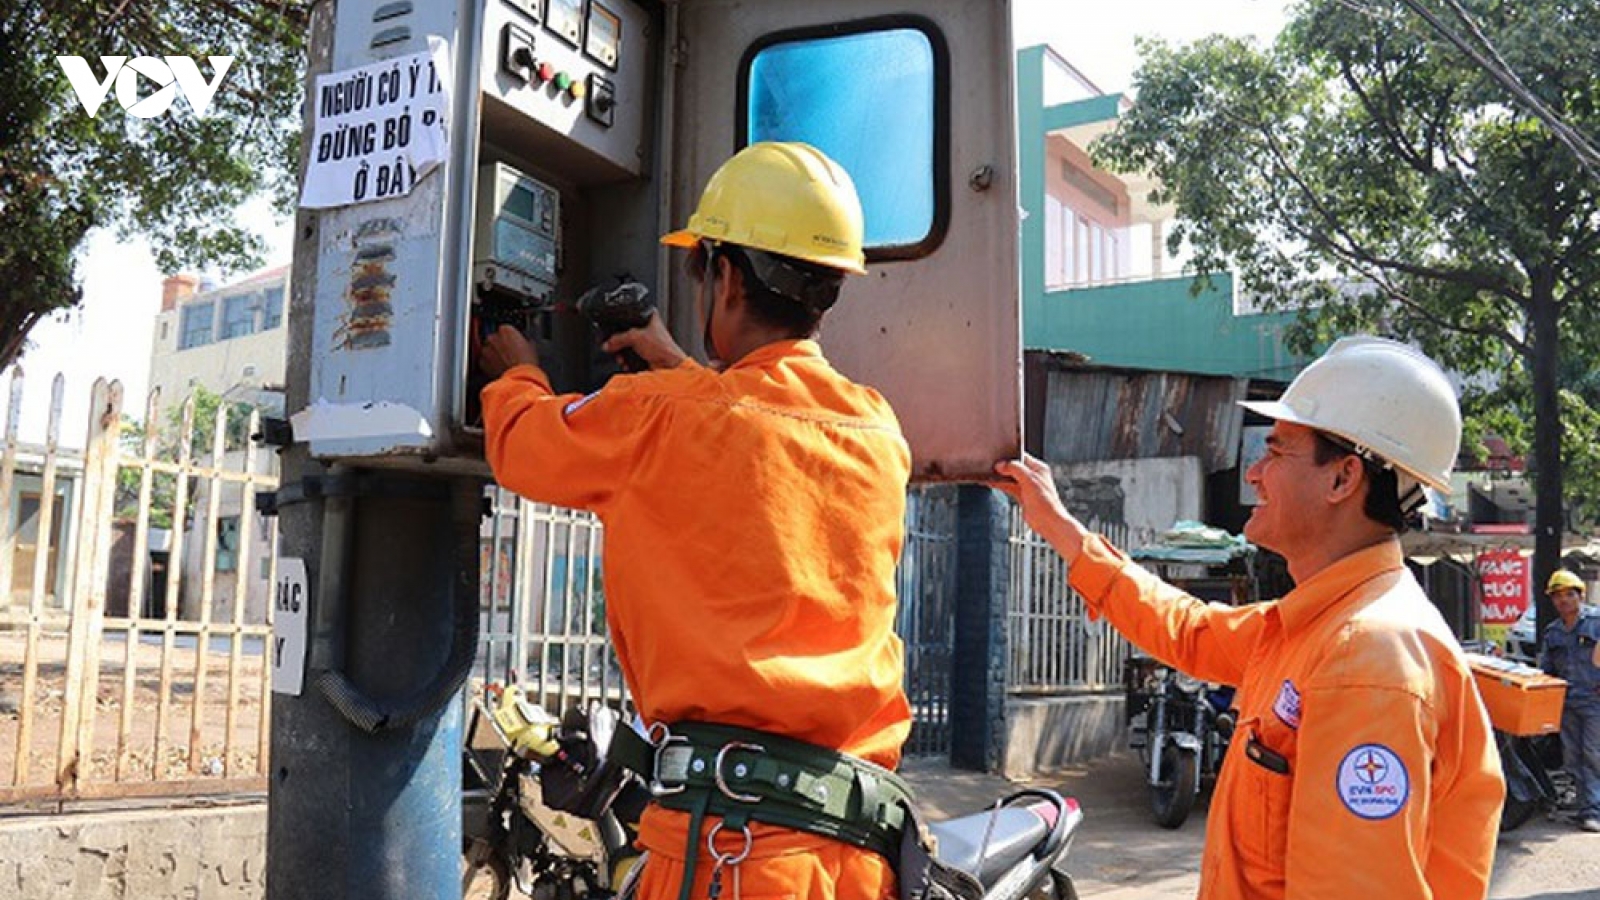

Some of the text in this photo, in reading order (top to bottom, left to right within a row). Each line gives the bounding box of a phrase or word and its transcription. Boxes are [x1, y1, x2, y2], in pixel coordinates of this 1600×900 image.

[320, 71, 374, 117] NGƯỜI
[378, 62, 400, 106] CÓ
[408, 57, 420, 98] Ý
[317, 123, 376, 163] ĐỪNG
[383, 105, 411, 150] BỎ
